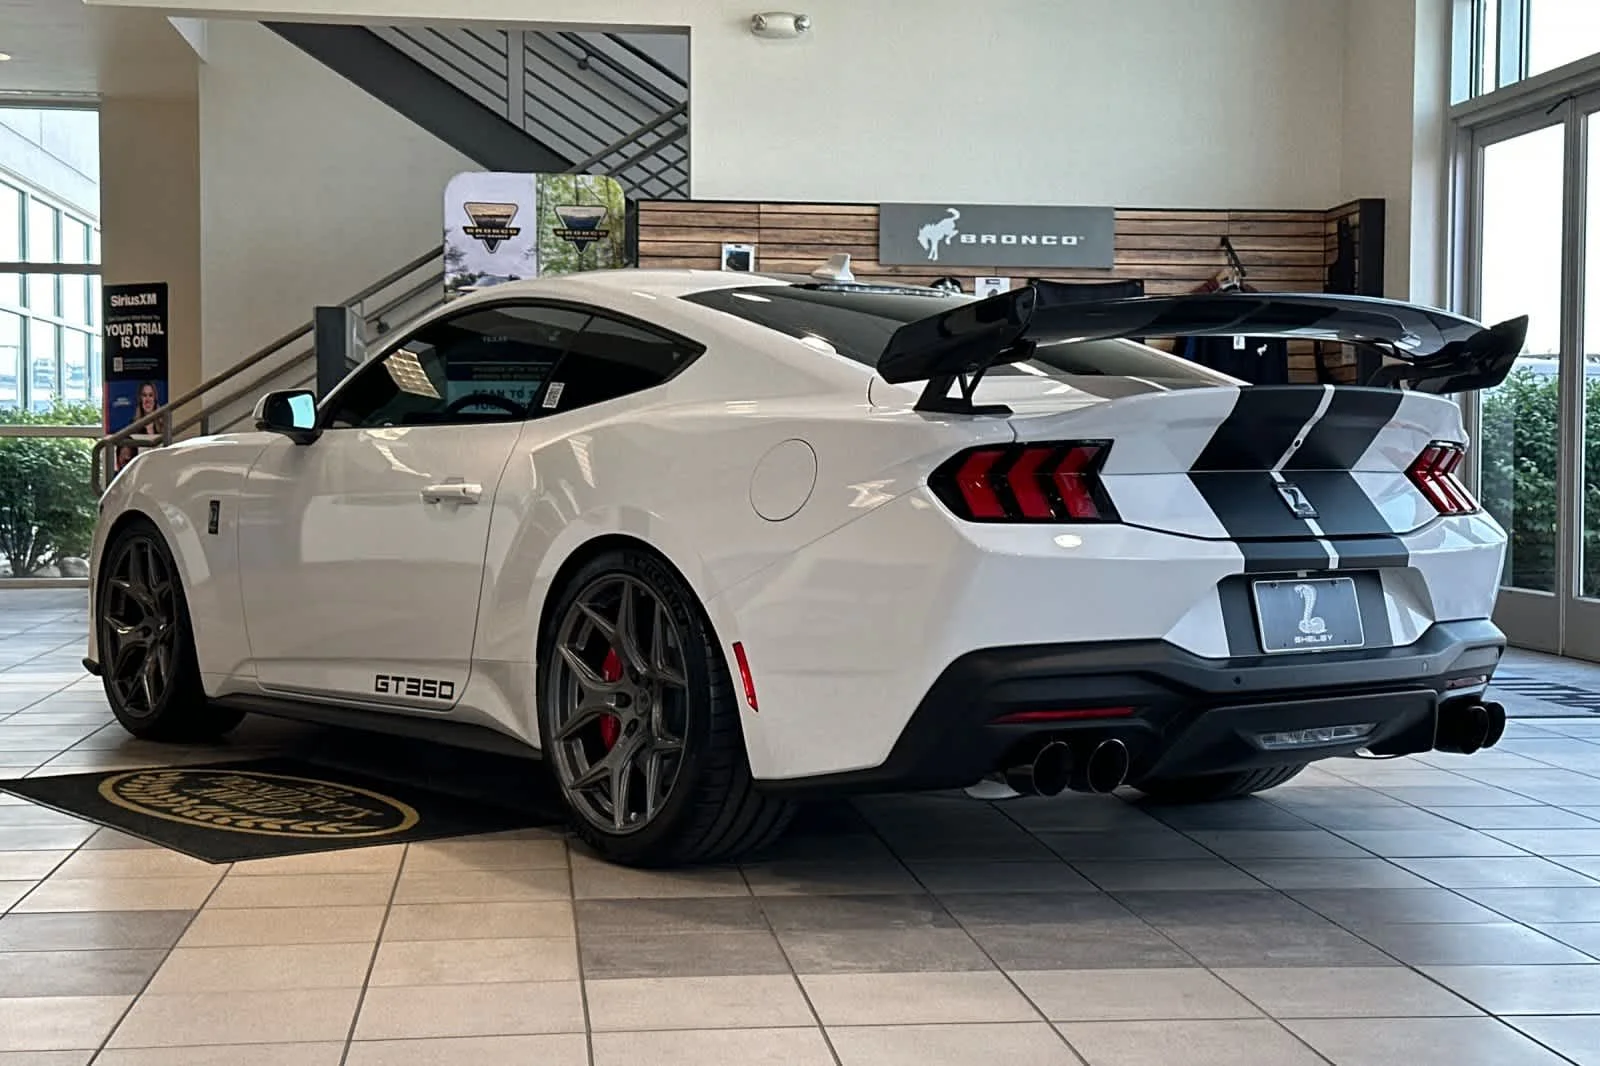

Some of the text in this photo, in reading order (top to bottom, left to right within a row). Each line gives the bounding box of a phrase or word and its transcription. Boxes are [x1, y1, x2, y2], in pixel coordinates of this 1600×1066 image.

[960, 233, 1078, 246] BRONCO
[110, 293, 158, 307] SiriusXM
[105, 322, 165, 336] YOUR TRIAL
[120, 335, 149, 348] IS ON
[1294, 634, 1333, 643] SHELBY
[375, 675, 455, 700] GT350
